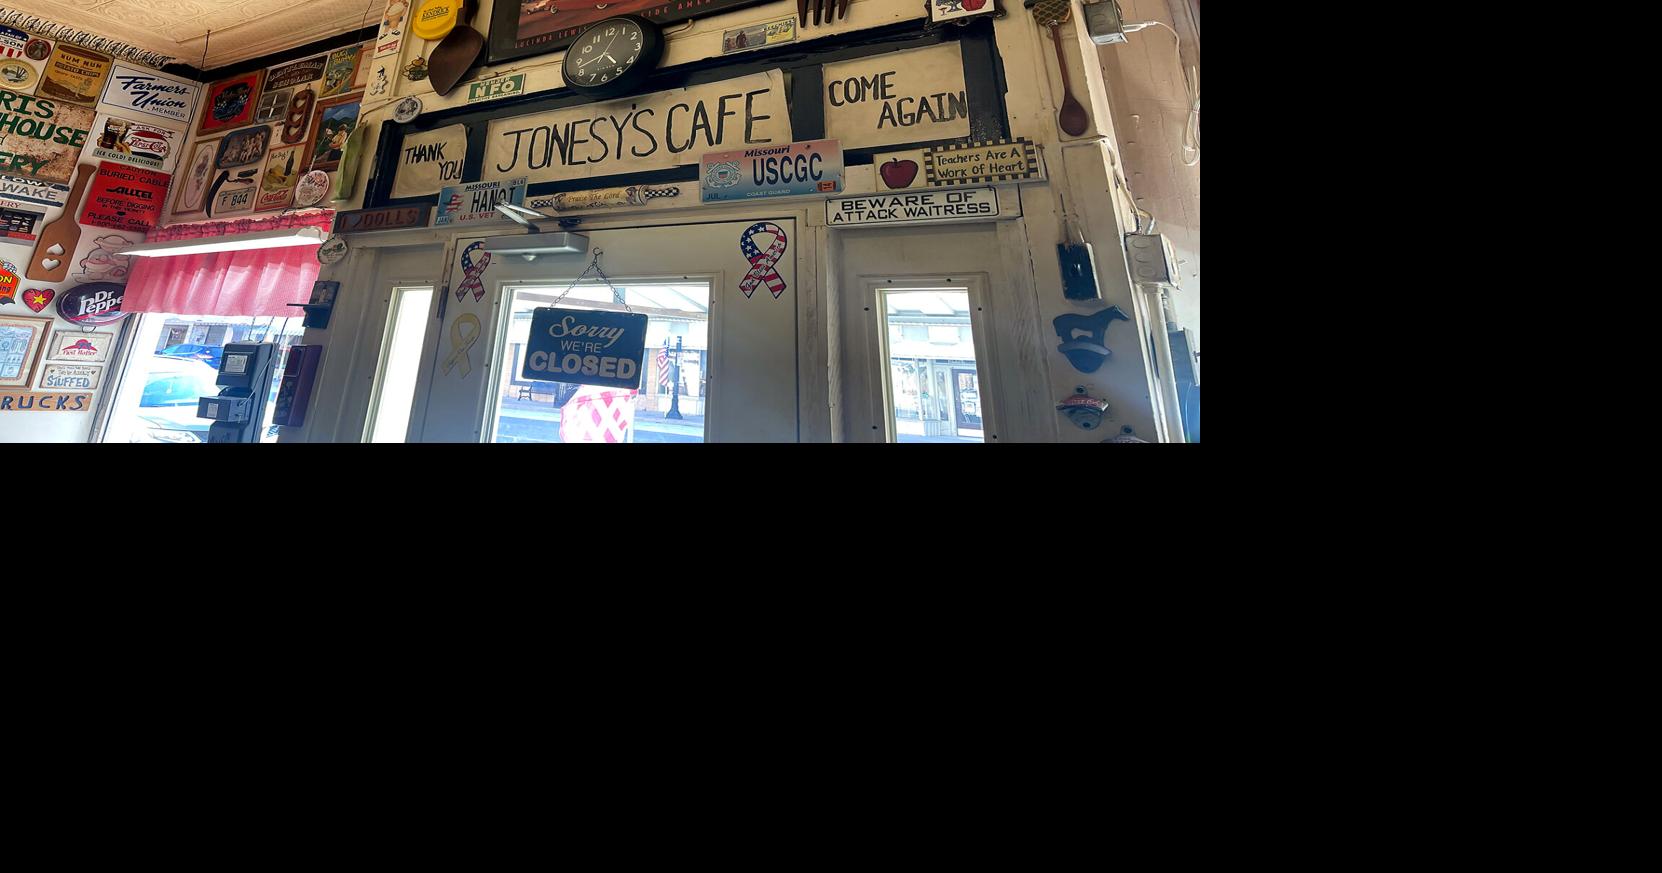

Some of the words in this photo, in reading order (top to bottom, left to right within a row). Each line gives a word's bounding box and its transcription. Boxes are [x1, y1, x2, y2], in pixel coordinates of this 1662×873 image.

[592, 35, 601, 44] 11
[605, 27, 615, 37] 12
[630, 31, 638, 41] 2
[581, 45, 593, 54] 10
[634, 42, 641, 51] 3
[575, 57, 583, 66] 9
[626, 55, 635, 64] 4
[577, 68, 585, 77] 8
[589, 73, 597, 83] 7
[600, 74, 608, 82] 6
[615, 66, 623, 76] 5
[116, 76, 190, 95] Farmers
[475, 80, 515, 98] NFO
[828, 70, 897, 108] COME
[130, 91, 187, 109] Union
[151, 106, 186, 119] MEMBER
[877, 90, 969, 130] AGAIN
[0, 112, 90, 147] HOUSE
[497, 102, 659, 174] JONESY'S
[665, 88, 774, 154] CAFE
[405, 142, 448, 165] THANK
[744, 145, 791, 158] Missouri
[936, 153, 980, 166] Teachers
[985, 150, 1007, 161] Are
[1010, 147, 1021, 158] A
[438, 158, 464, 181] YOU
[753, 152, 823, 186] USCGC
[937, 168, 968, 179] Work
[989, 160, 1025, 173] Heart
[99, 168, 136, 182] BURIED
[138, 176, 170, 188] CABLE
[2, 182, 58, 201] WAKE
[464, 181, 500, 192] MISSOURI
[96, 195, 125, 207] BEFORE
[126, 201, 156, 211] DIGGING
[231, 193, 248, 206] 844
[567, 195, 588, 203] Praise
[590, 193, 601, 201] The
[604, 191, 620, 200] Lord
[706, 193, 721, 201] JUL
[840, 194, 935, 212] BEWARE
[945, 190, 977, 204] OF
[87, 211, 122, 223] PLEASE
[127, 218, 150, 227] CALL
[458, 213, 476, 221] U.S.
[478, 211, 496, 220] VET
[832, 208, 899, 223] ATTACK
[903, 202, 991, 218] WAITRESS
[95, 290, 115, 303] Dr
[77, 295, 124, 316] Peppe
[548, 315, 626, 349] Sorry
[560, 339, 602, 353] WE'RE
[528, 350, 637, 380] CLOSED
[47, 374, 90, 388] STUFFED
[0, 395, 86, 411] RUCKS
